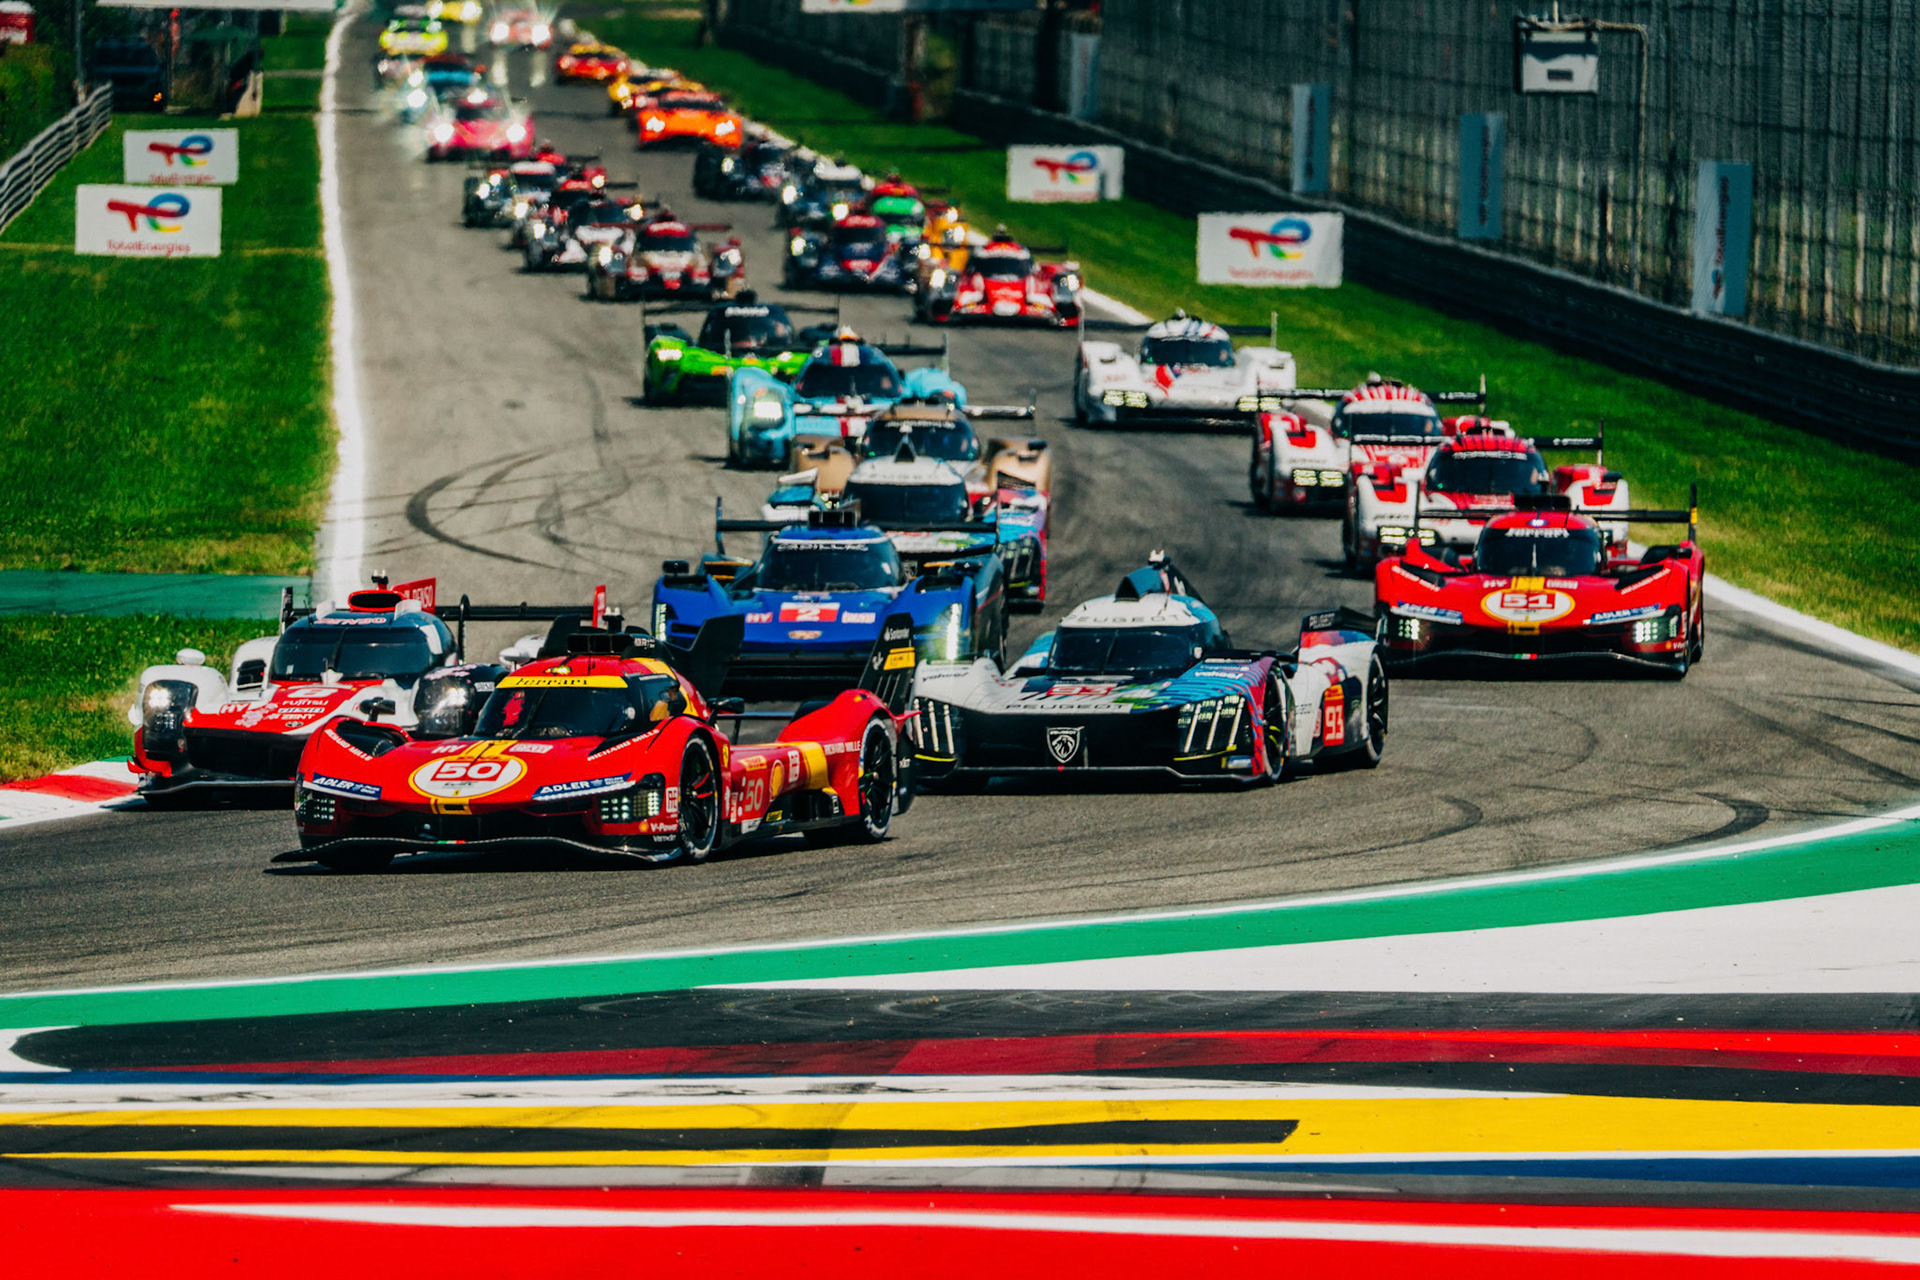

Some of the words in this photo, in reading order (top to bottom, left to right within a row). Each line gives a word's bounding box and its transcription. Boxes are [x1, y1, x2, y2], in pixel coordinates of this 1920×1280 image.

[1503, 593, 1553, 608] 51
[795, 607, 821, 622] 2
[515, 677, 588, 686] Ferrari
[220, 703, 251, 715] HY
[1325, 705, 1344, 740] 93
[632, 729, 661, 743] MILLE
[432, 744, 468, 754] HY
[435, 762, 502, 780] 50
[312, 777, 355, 790] ADLER
[540, 782, 590, 794] ADLER
[745, 777, 764, 812] 50
